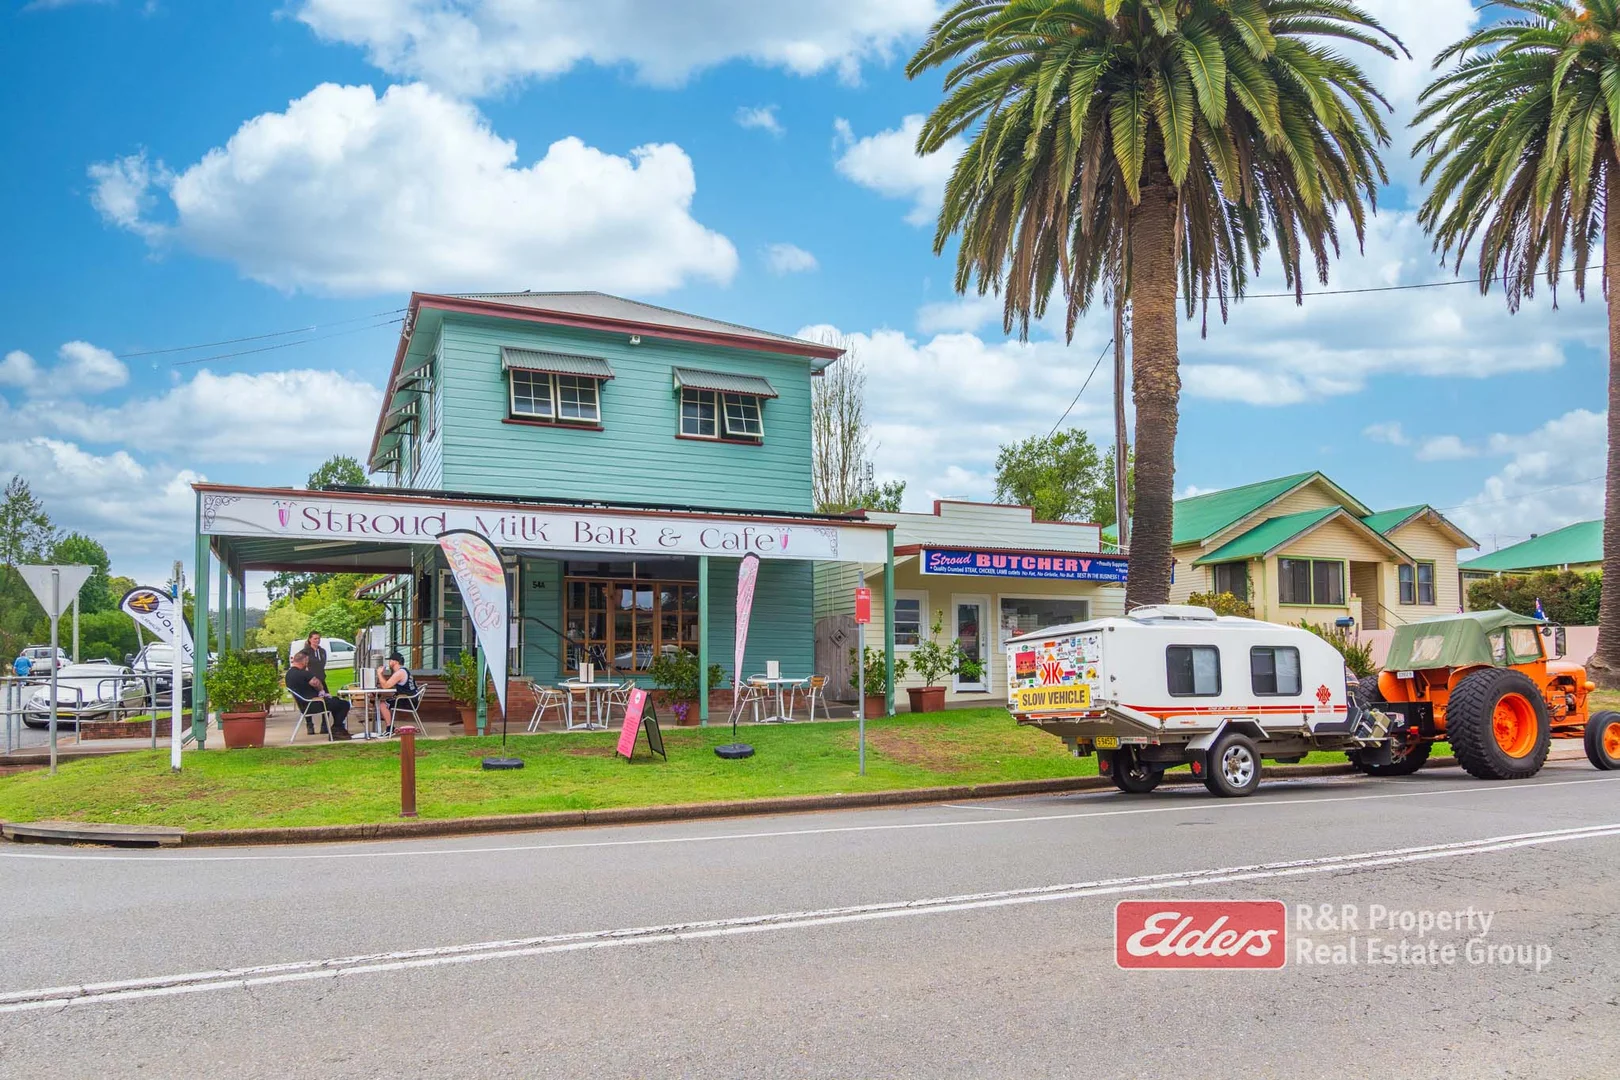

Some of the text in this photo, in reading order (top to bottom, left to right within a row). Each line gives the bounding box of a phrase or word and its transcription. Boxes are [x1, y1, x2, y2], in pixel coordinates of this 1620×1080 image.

[301, 505, 774, 551] Stroud Milk Bar & Cafe
[930, 552, 1091, 572] Stroud BUTCHERY
[1022, 690, 1085, 706] SLOW VEHICLE
